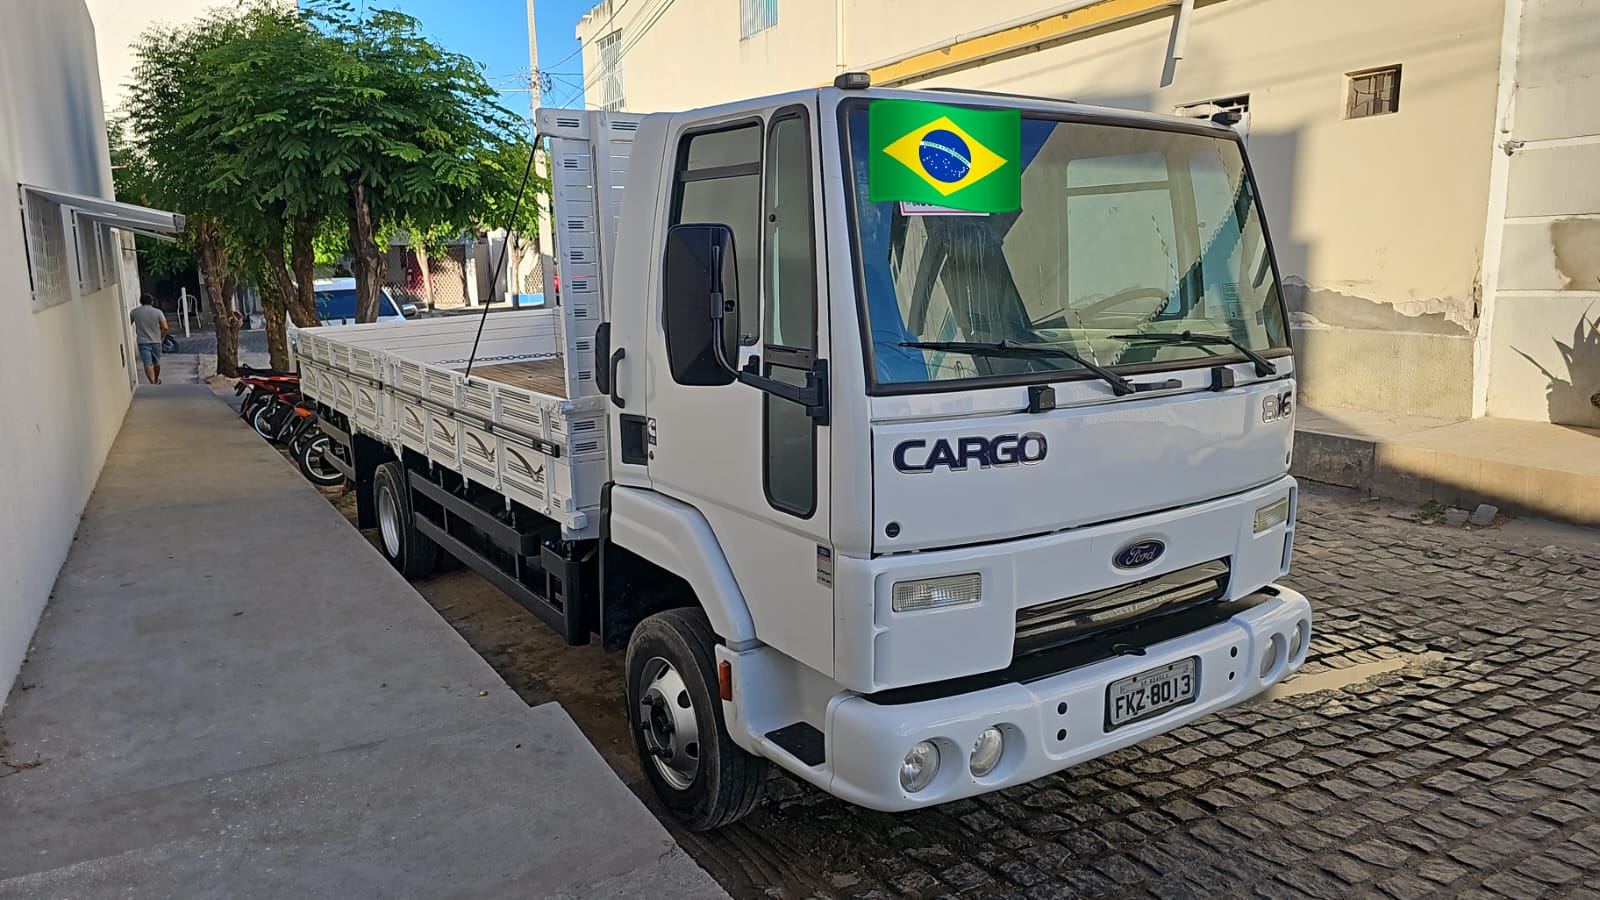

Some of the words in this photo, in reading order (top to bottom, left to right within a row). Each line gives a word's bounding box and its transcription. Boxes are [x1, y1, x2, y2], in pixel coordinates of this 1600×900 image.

[1262, 391, 1292, 423] 816
[893, 432, 1048, 474] CARGO
[1126, 544, 1157, 565] Ford
